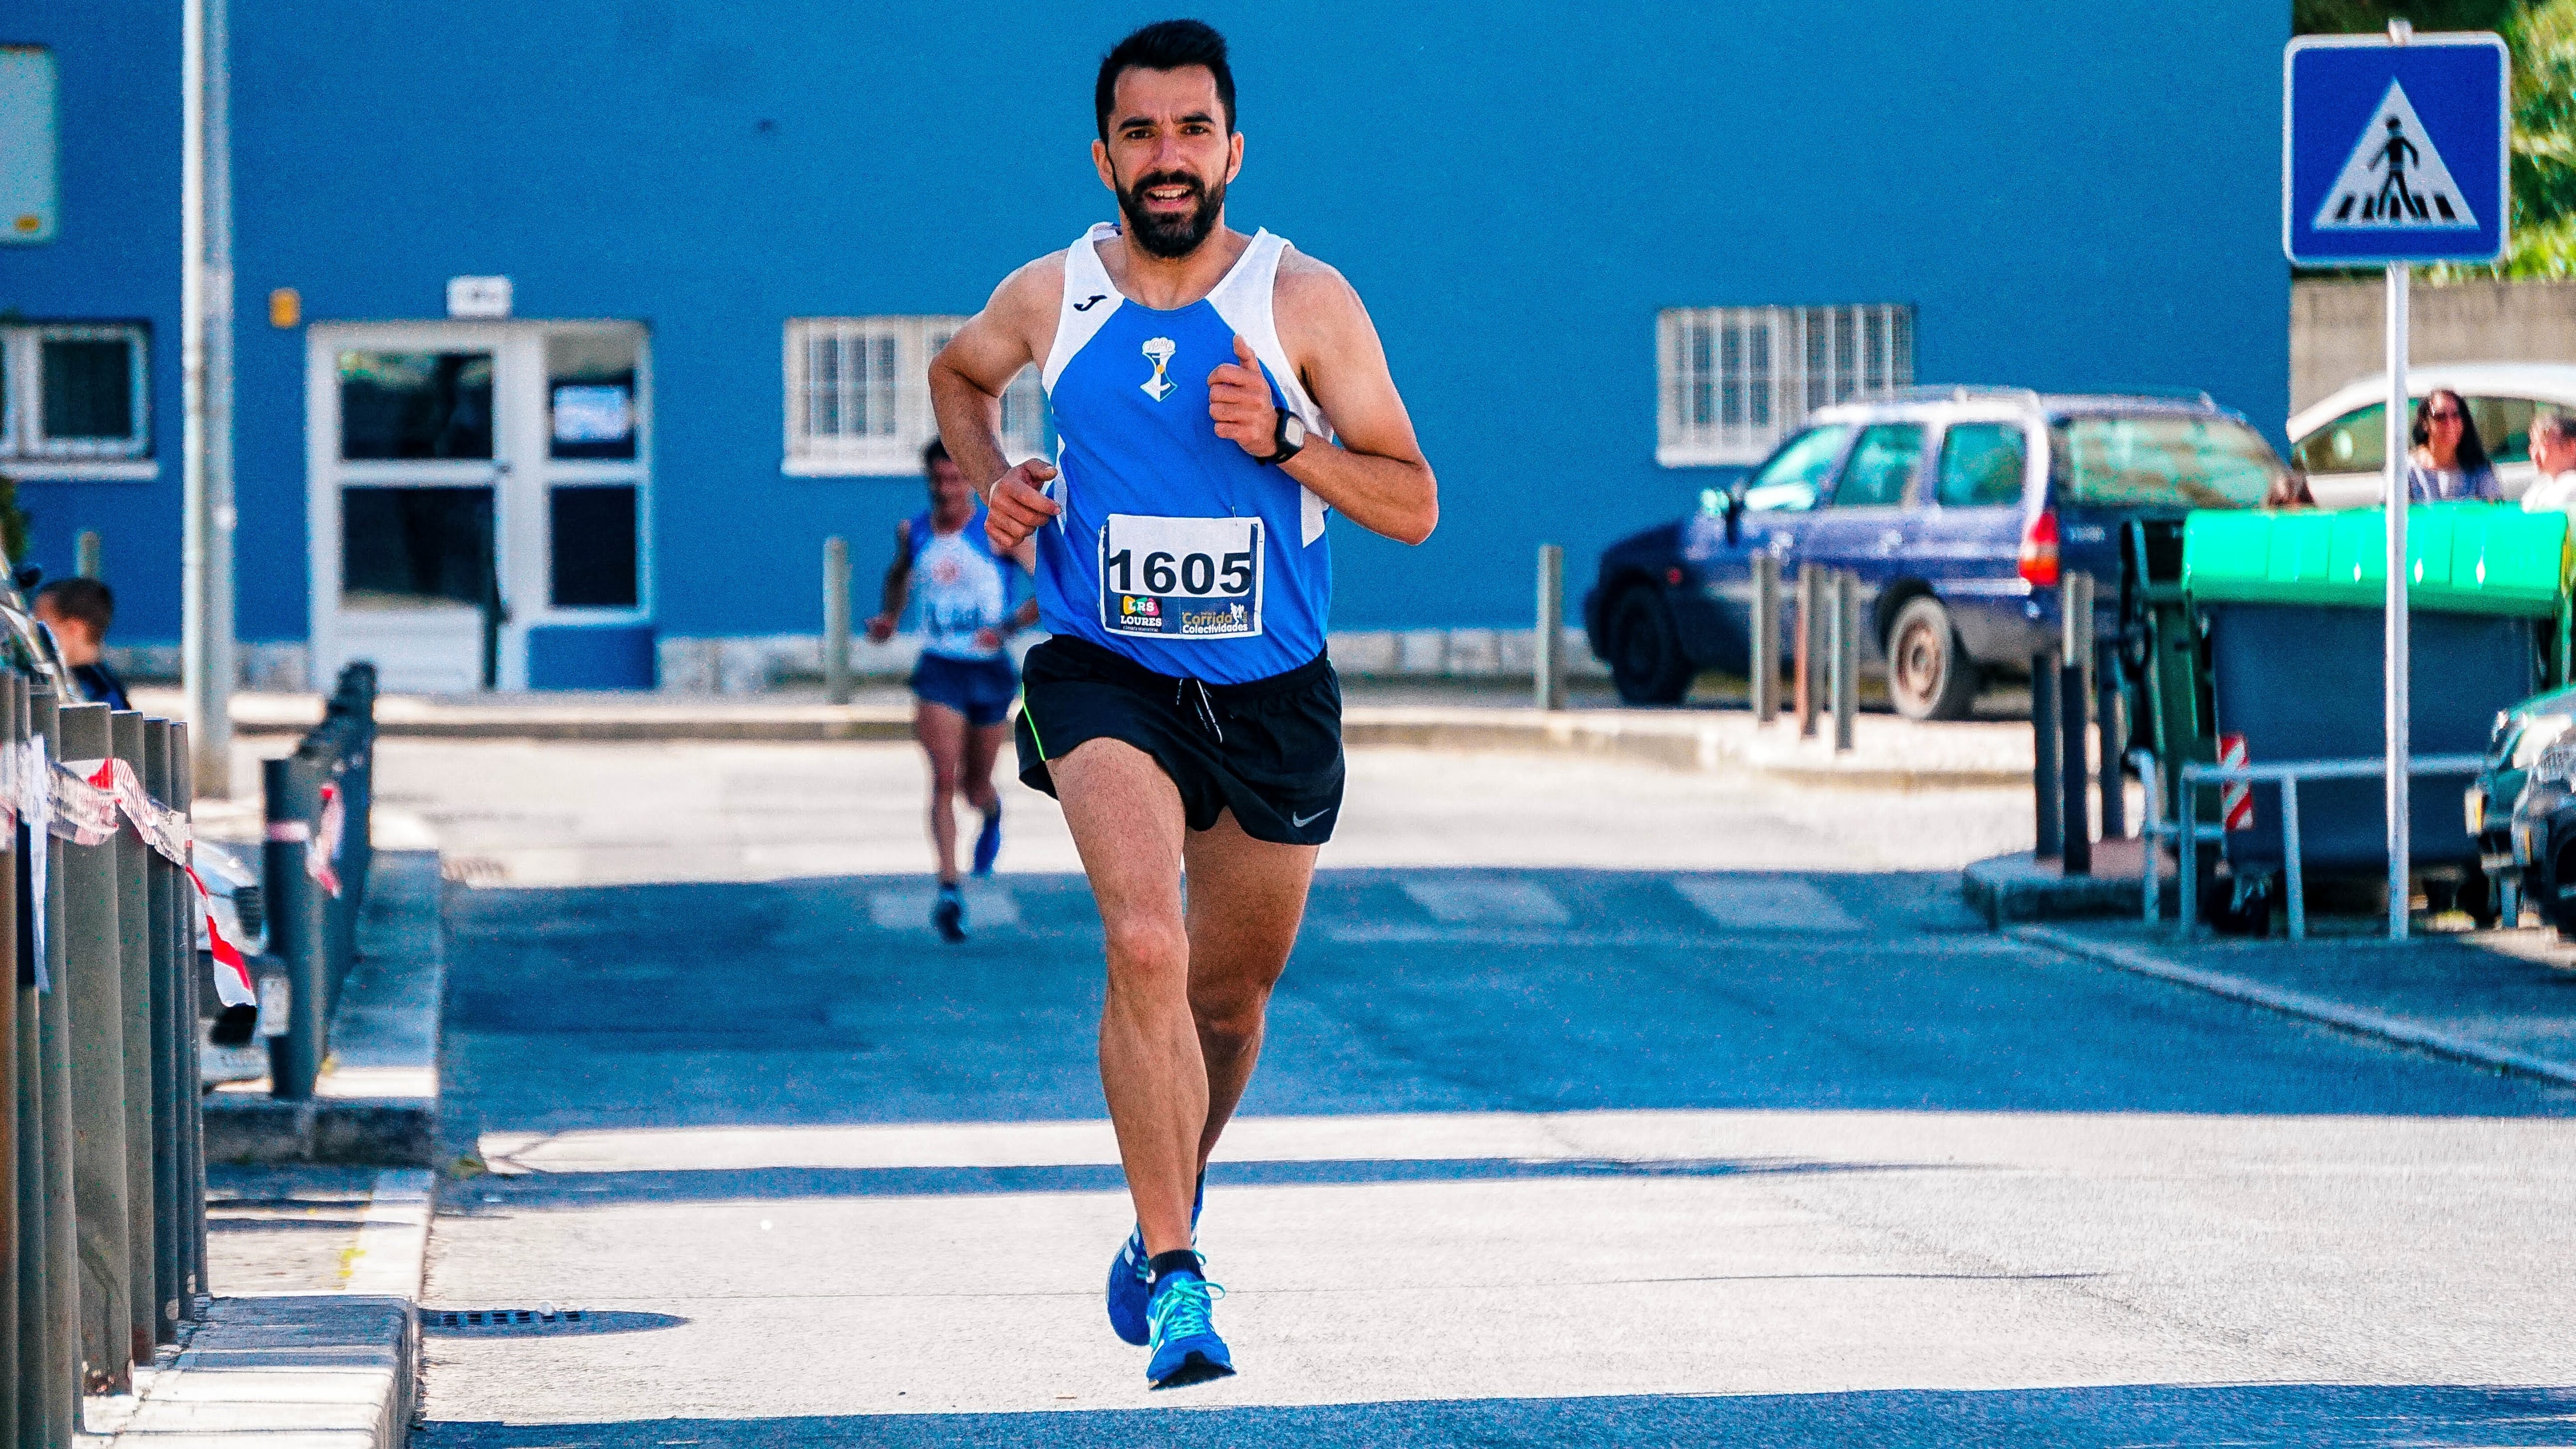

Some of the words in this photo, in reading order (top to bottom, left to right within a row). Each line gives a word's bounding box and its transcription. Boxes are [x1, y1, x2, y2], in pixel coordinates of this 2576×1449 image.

[1109, 549, 1252, 595] 1605
[1128, 601, 1155, 612] LRS
[1121, 616, 1163, 626] LOURES
[1182, 611, 1233, 625] Corrida
[1182, 623, 1248, 633] Colectividades
